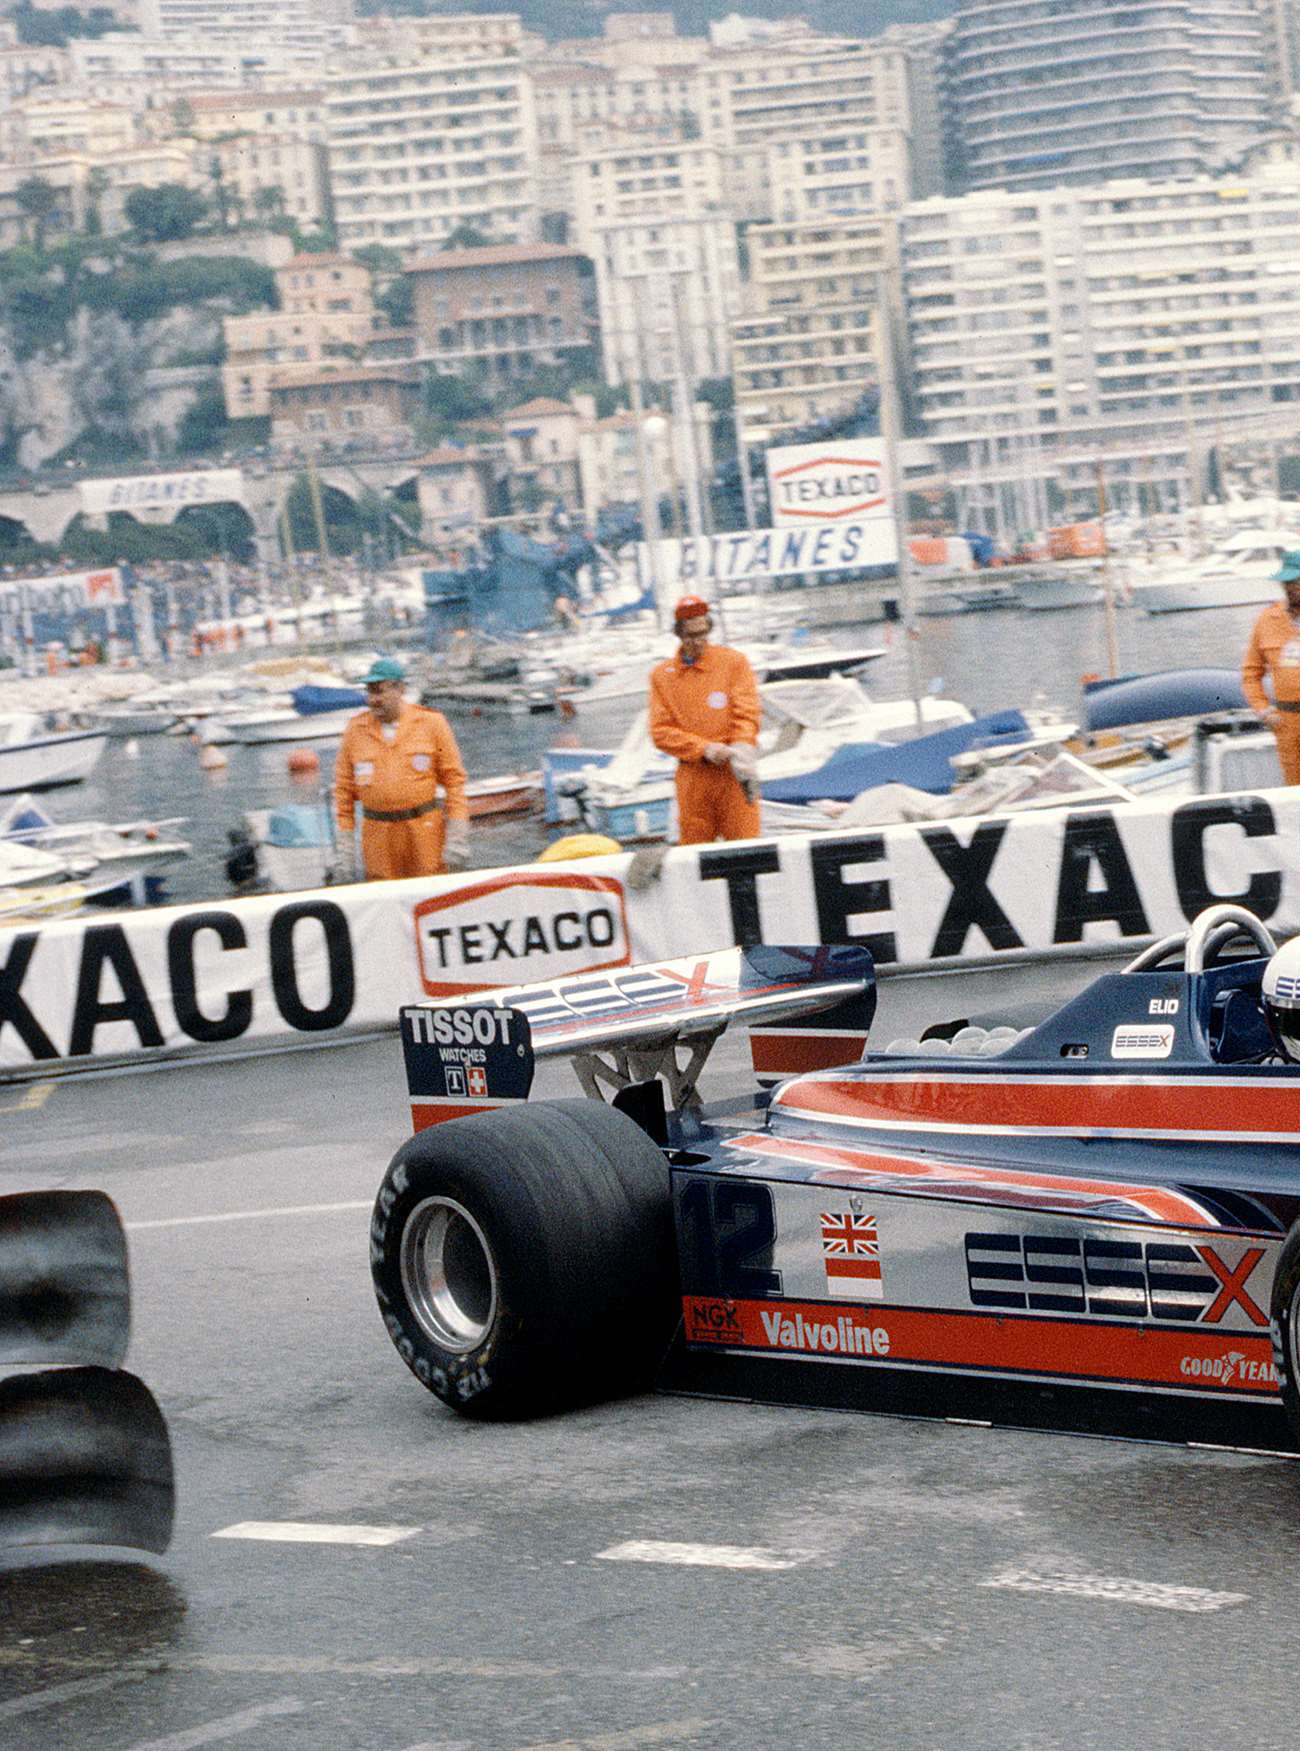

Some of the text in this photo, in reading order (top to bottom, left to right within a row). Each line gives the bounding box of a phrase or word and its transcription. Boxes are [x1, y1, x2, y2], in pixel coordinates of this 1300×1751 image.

[781, 472, 880, 503] TEXACO
[681, 525, 864, 578] GITANES
[428, 907, 616, 968] TEXACO
[0, 899, 355, 1060] XACO
[1148, 999, 1179, 1015] ELIO
[404, 1008, 513, 1046] TISSOT
[1114, 1033, 1171, 1050] ESSEX
[438, 1046, 488, 1063] WATCHES
[965, 1231, 1271, 1328] ESSEX
[693, 1304, 740, 1328] NGK
[760, 1311, 890, 1356] Valvoline
[1180, 1356, 1224, 1378] GOOD
